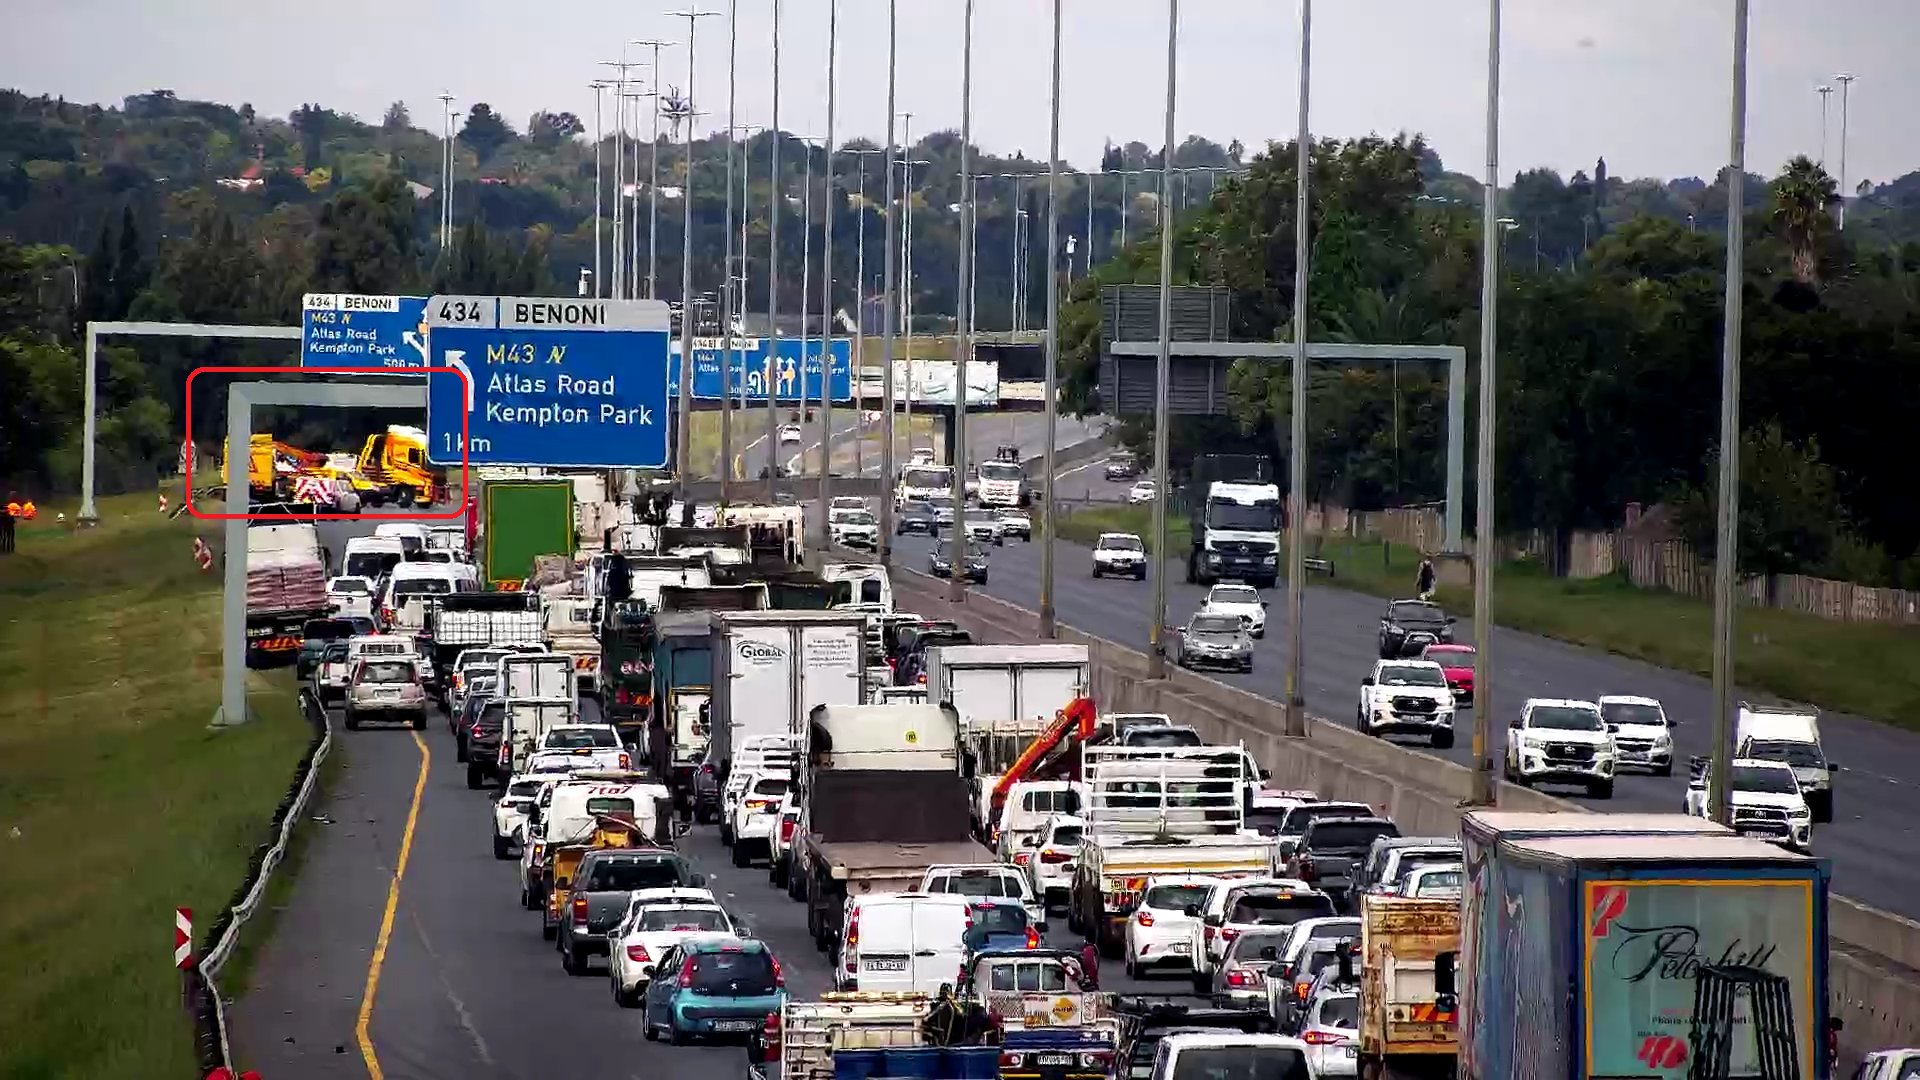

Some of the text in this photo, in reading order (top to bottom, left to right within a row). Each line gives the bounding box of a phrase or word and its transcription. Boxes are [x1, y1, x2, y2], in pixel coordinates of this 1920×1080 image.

[345, 297, 391, 309] BENONI
[439, 303, 605, 324] 434 BENONI
[311, 327, 377, 341] Atlas Road
[310, 342, 396, 355] Kempton Park
[487, 344, 567, 364] M43 N
[487, 372, 615, 396] Atlas Road
[486, 402, 652, 427] Kempton Park
[740, 645, 782, 658] GLOBAL
